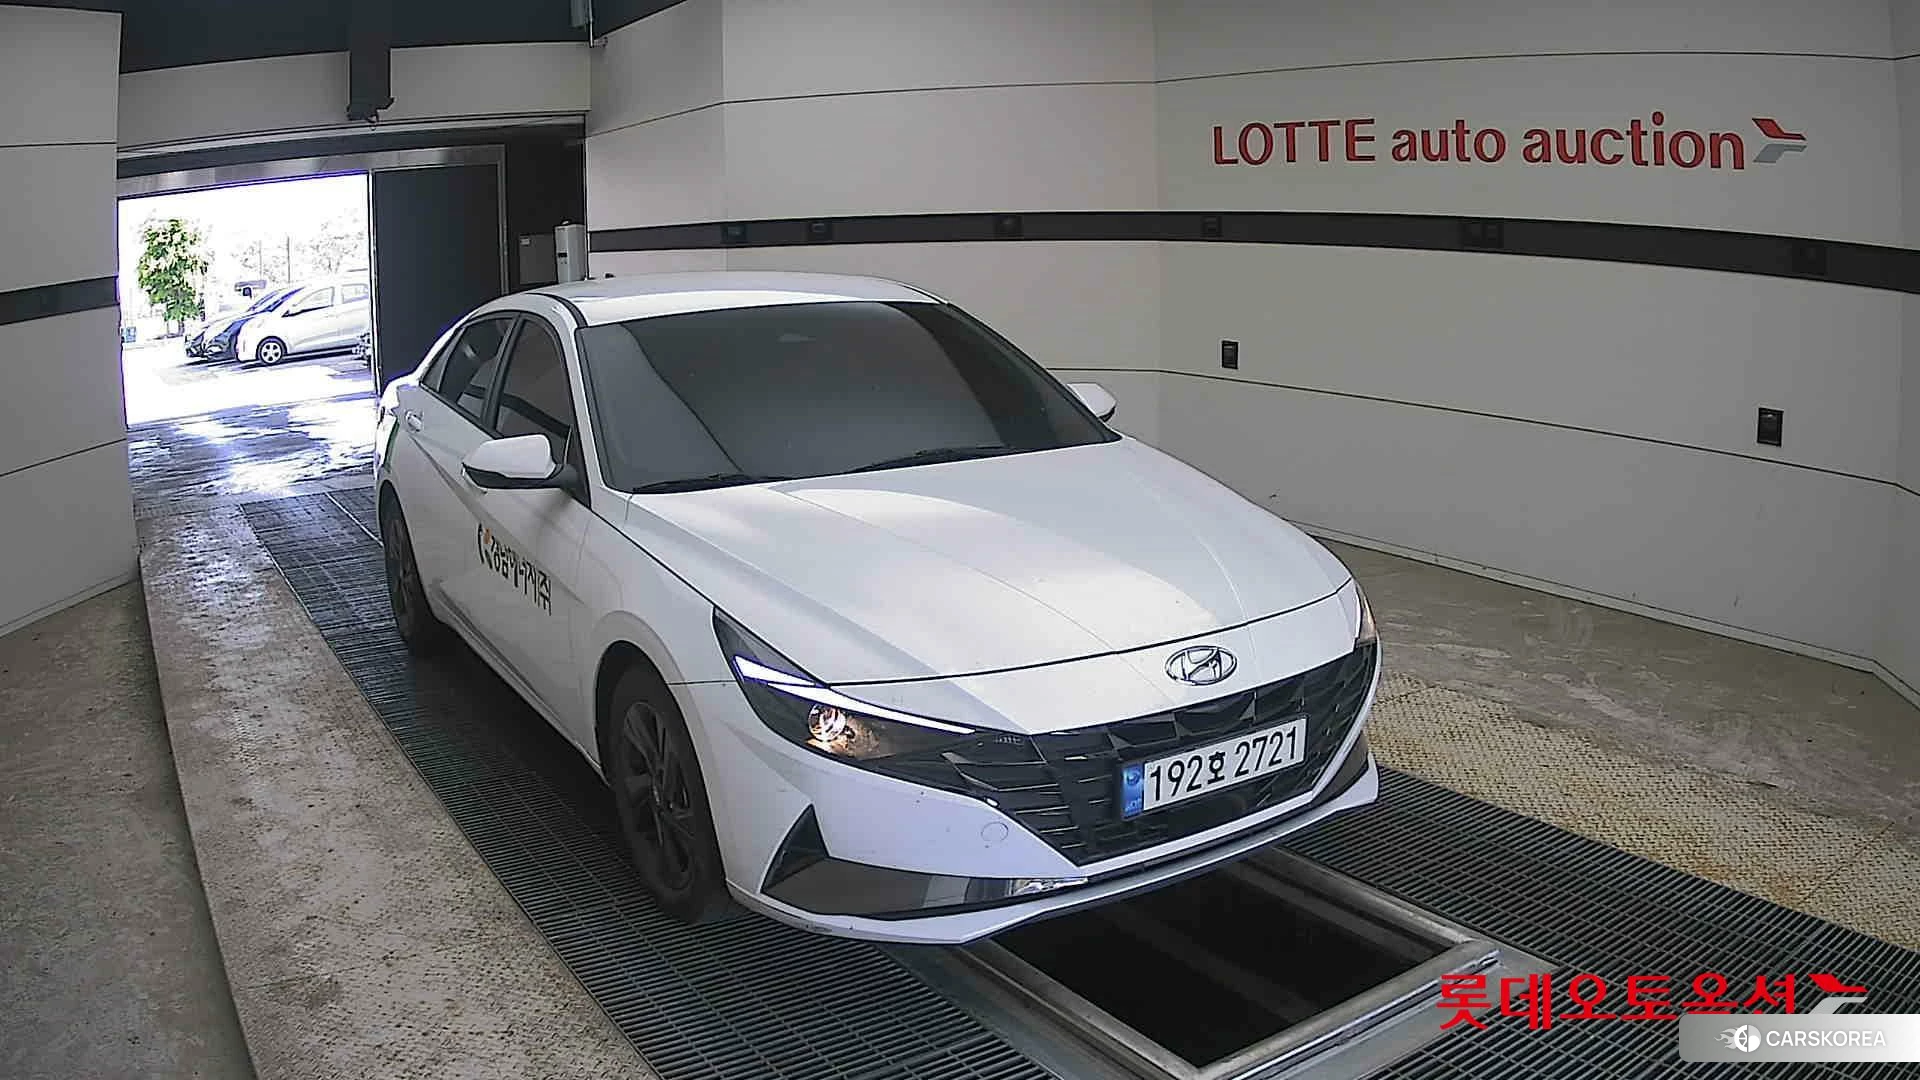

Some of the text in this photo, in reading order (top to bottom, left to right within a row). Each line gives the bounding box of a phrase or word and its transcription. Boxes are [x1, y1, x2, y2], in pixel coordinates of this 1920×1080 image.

[1212, 111, 1746, 170] LOTTE auto auction
[1150, 726, 1297, 801] 192호 2721
